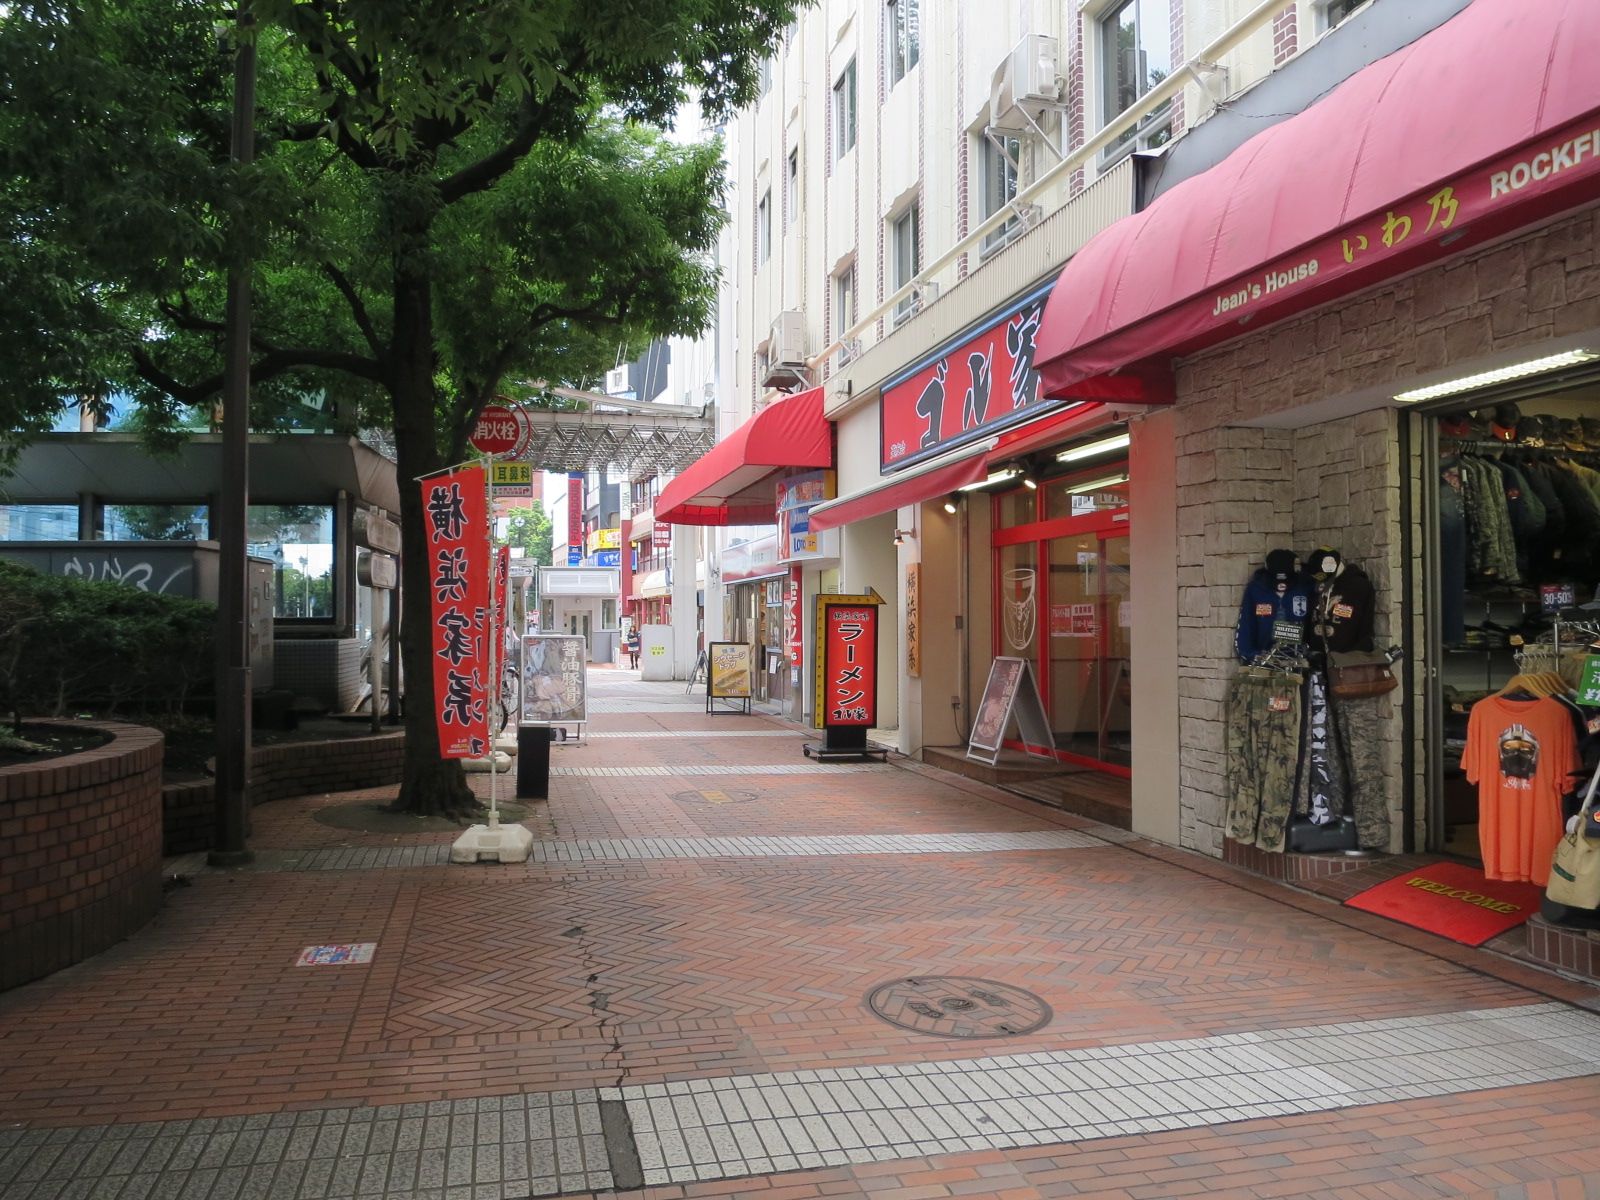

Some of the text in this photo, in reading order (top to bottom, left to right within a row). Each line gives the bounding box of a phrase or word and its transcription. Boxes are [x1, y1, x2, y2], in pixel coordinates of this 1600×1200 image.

[1341, 186, 1459, 264] いわ乃
[1212, 258, 1319, 316] Jean's House
[473, 421, 517, 441] 消火栓
[836, 623, 865, 706] ラーメン
[1405, 876, 1521, 914] WELCOME
